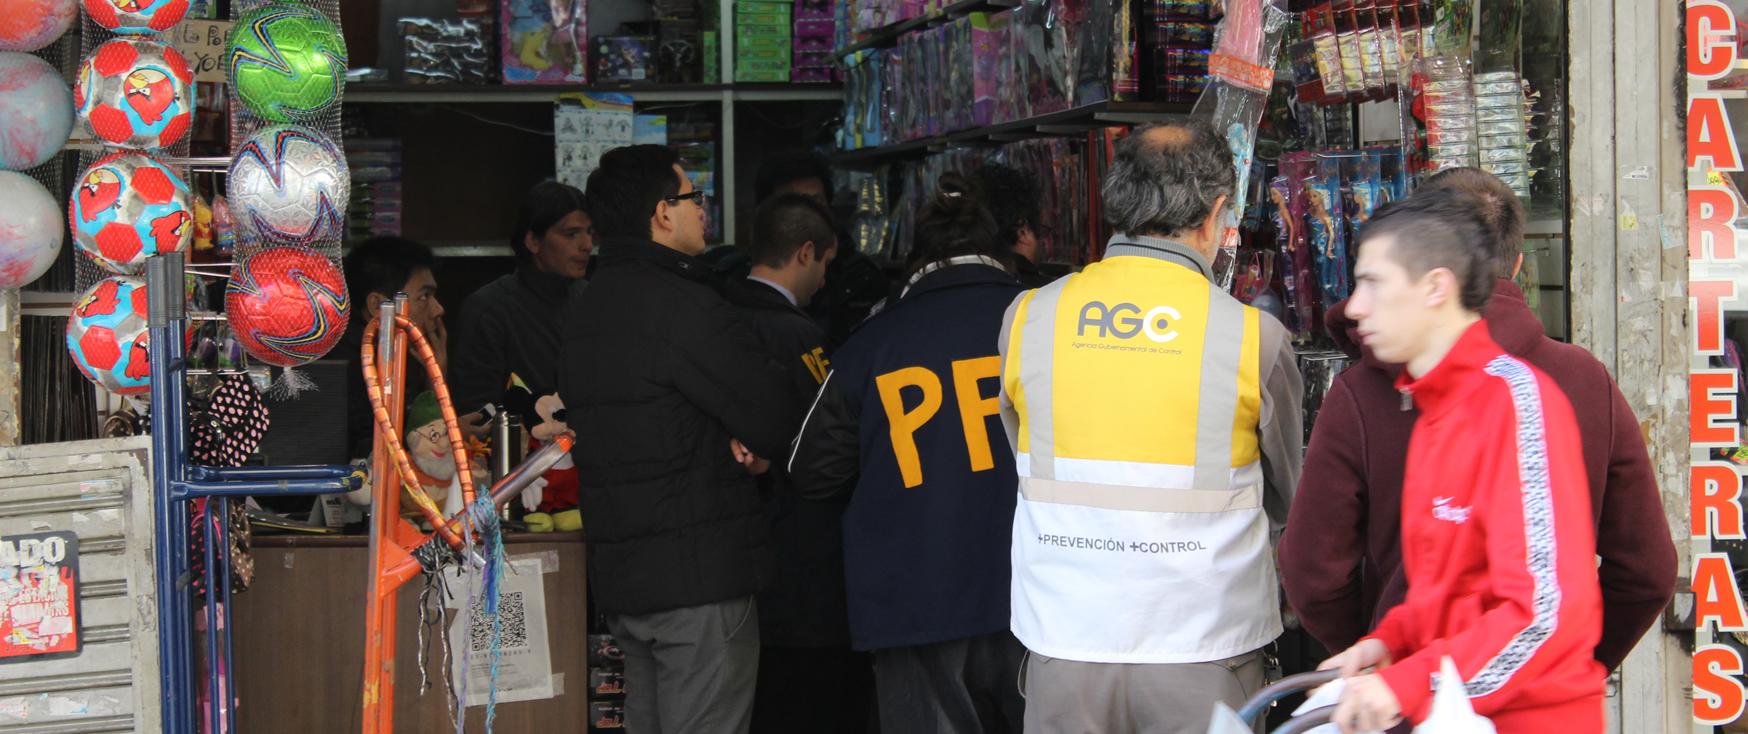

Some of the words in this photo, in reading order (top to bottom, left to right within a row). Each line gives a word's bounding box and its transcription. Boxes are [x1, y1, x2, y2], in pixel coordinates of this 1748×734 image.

[1077, 300, 1182, 343] AGC
[1071, 341, 1097, 349] Agencia
[1098, 343, 1147, 353] Gubernamental
[1158, 347, 1182, 355] Control
[1687, 1, 1747, 726] CARTERAS
